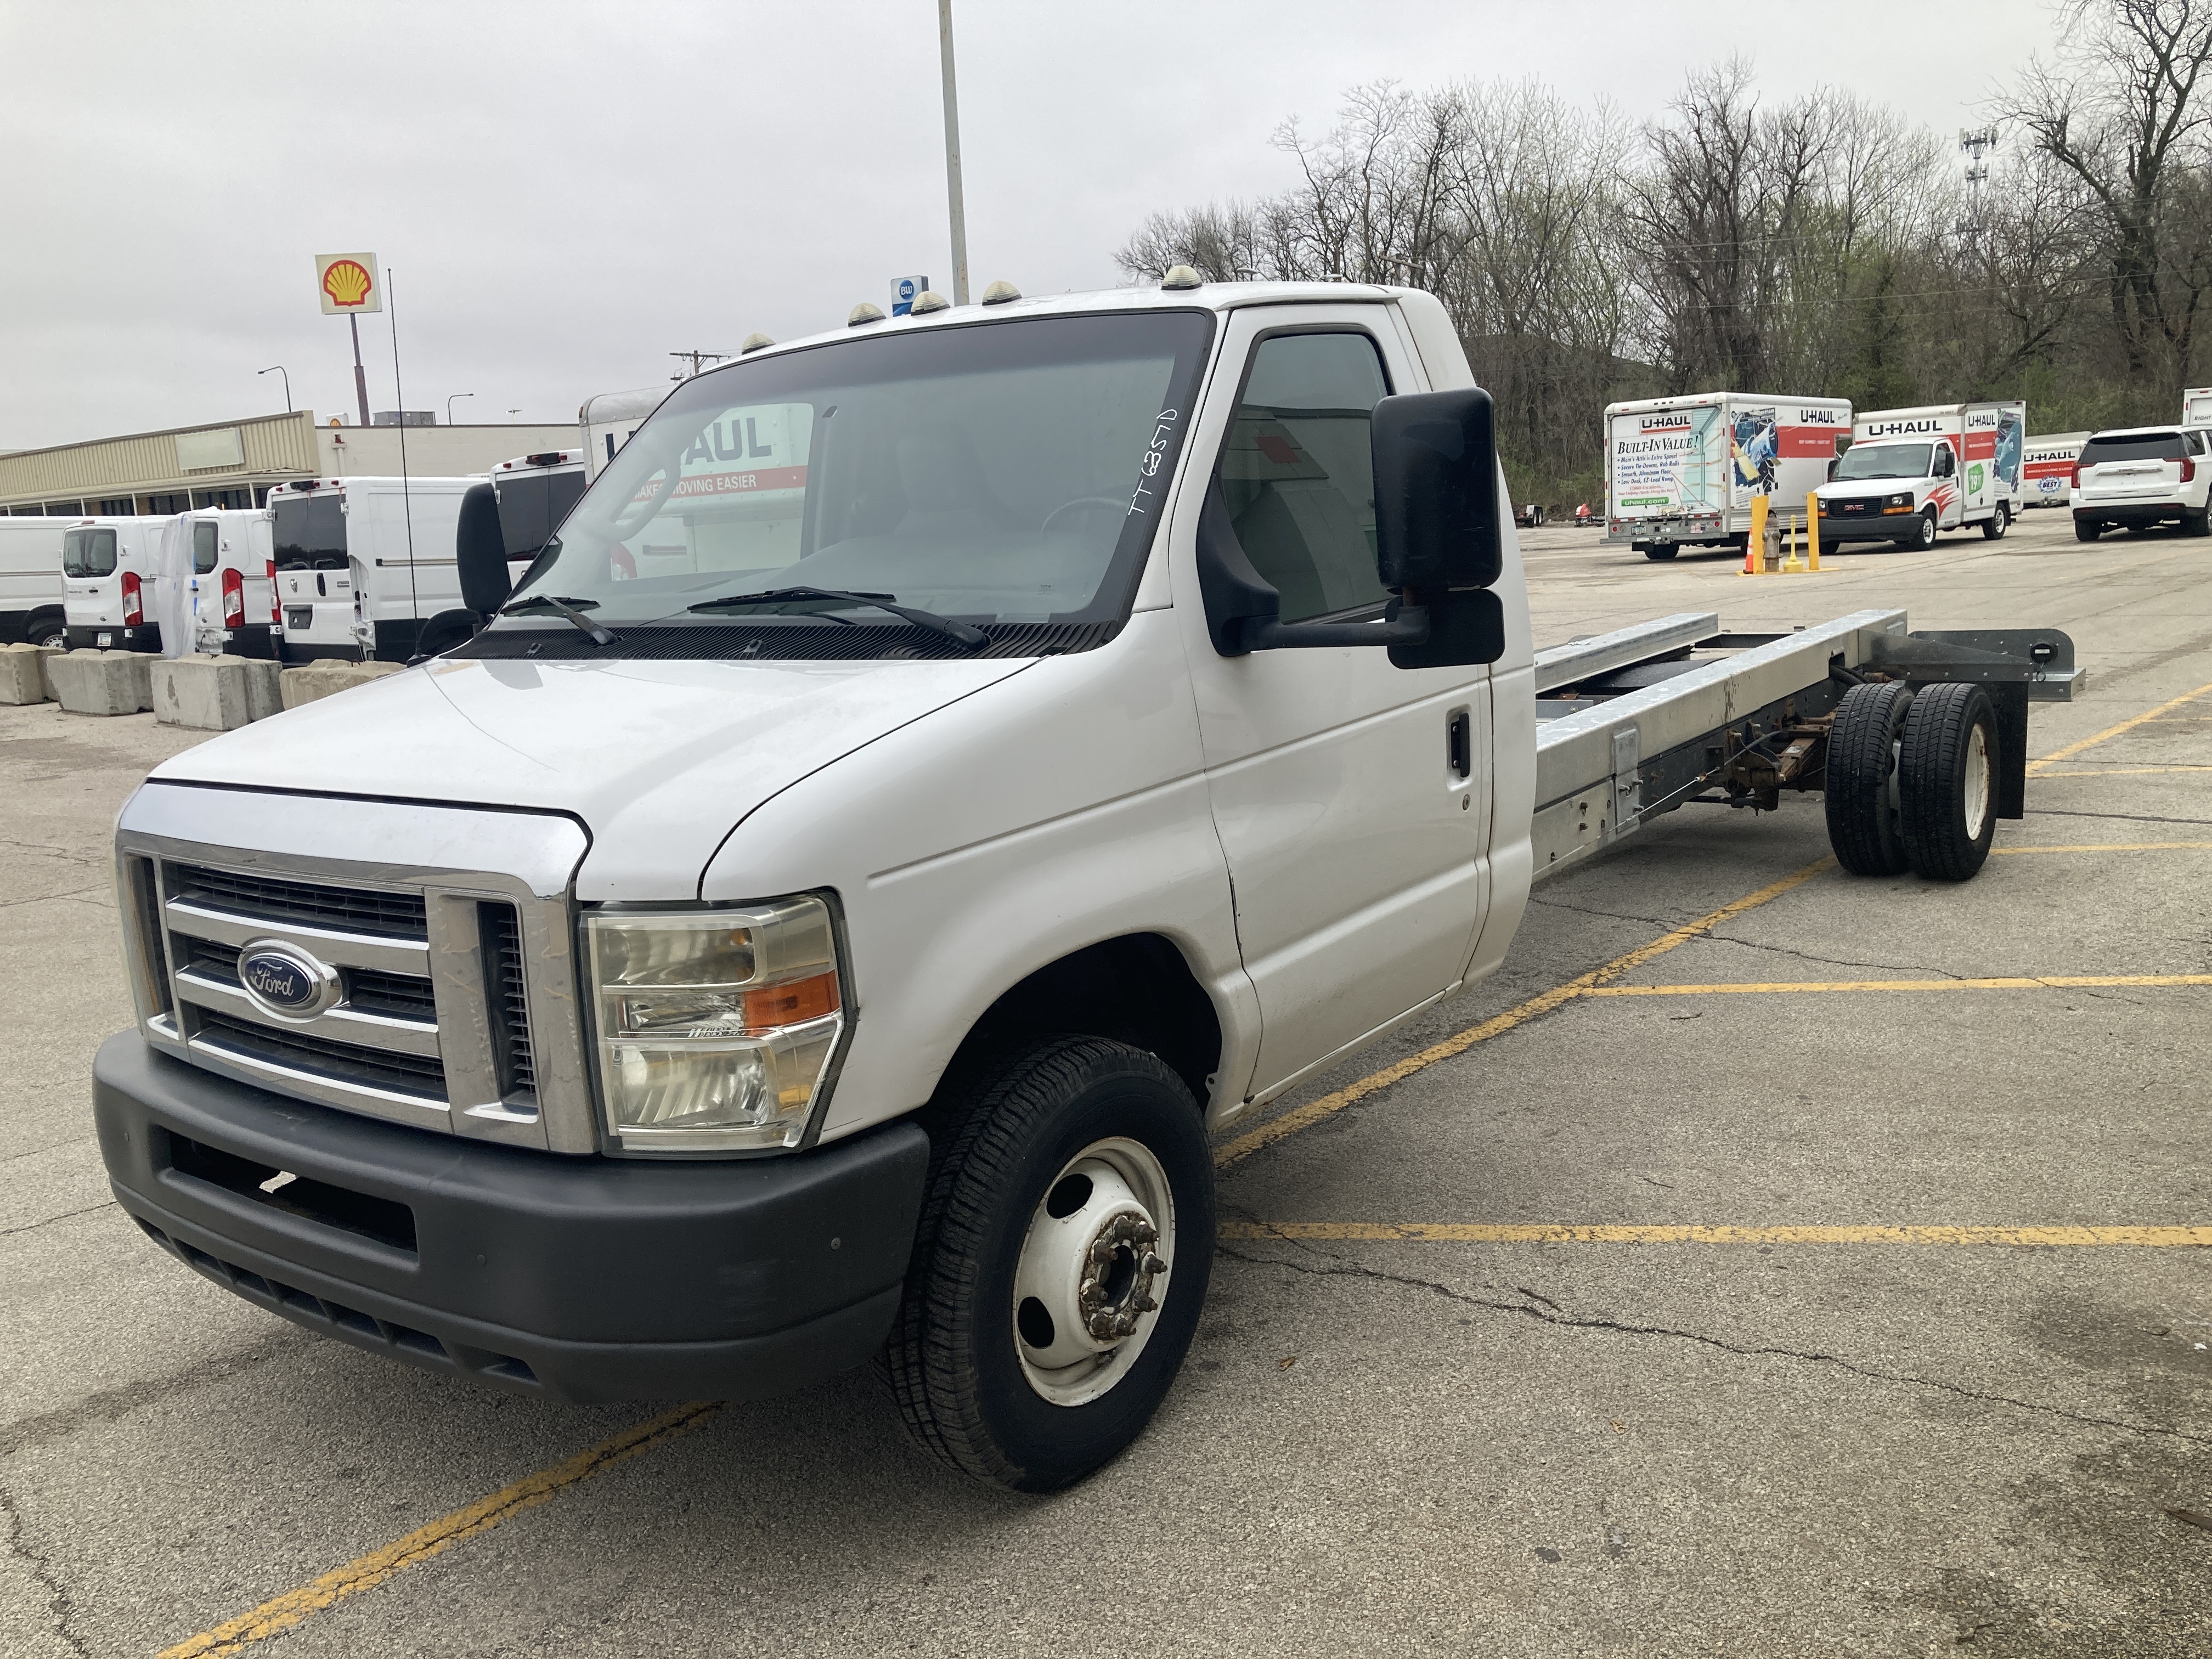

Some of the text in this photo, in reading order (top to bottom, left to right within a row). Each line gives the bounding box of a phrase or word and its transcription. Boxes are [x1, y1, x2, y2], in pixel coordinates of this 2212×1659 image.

[1642, 416, 1691, 428] U-HAUL
[1801, 410, 1835, 424] U-HAUL
[1968, 414, 1995, 427] U-HAUL
[1869, 420, 1943, 436] U-HAUL
[2024, 451, 2075, 462] U-HAUL
[716, 475, 757, 490] EASIER
[250, 961, 294, 997] Ford
